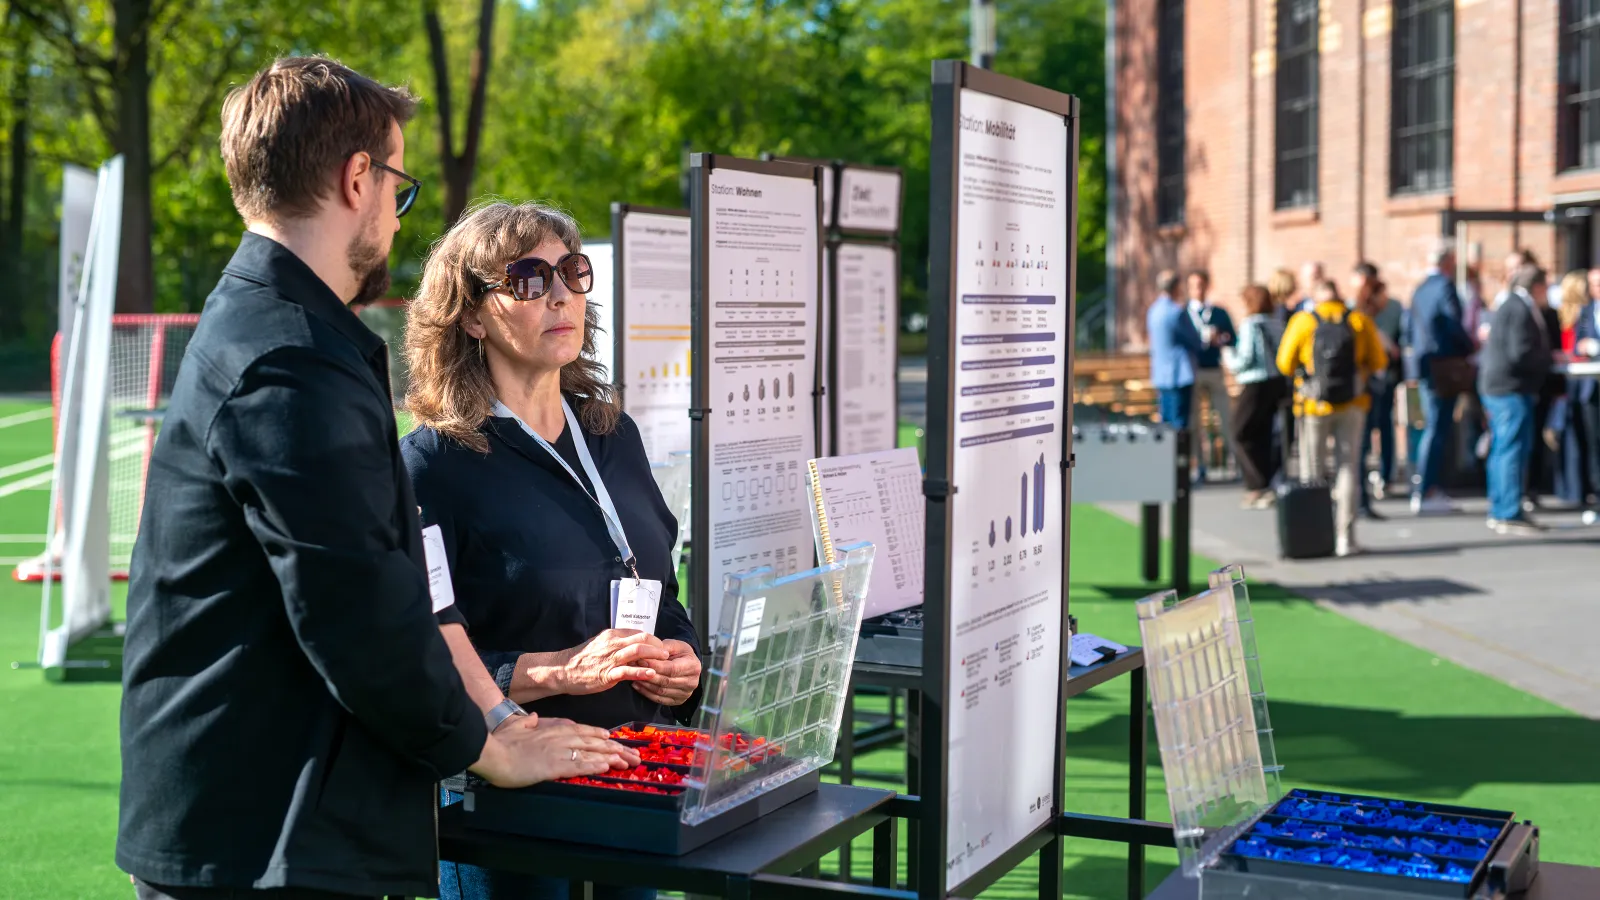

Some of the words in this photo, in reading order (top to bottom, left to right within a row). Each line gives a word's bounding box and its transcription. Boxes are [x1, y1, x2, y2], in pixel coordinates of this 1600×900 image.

[985, 119, 1016, 141] Mobilität
[711, 183, 734, 196] Station:
[735, 186, 762, 198] Wohnen
